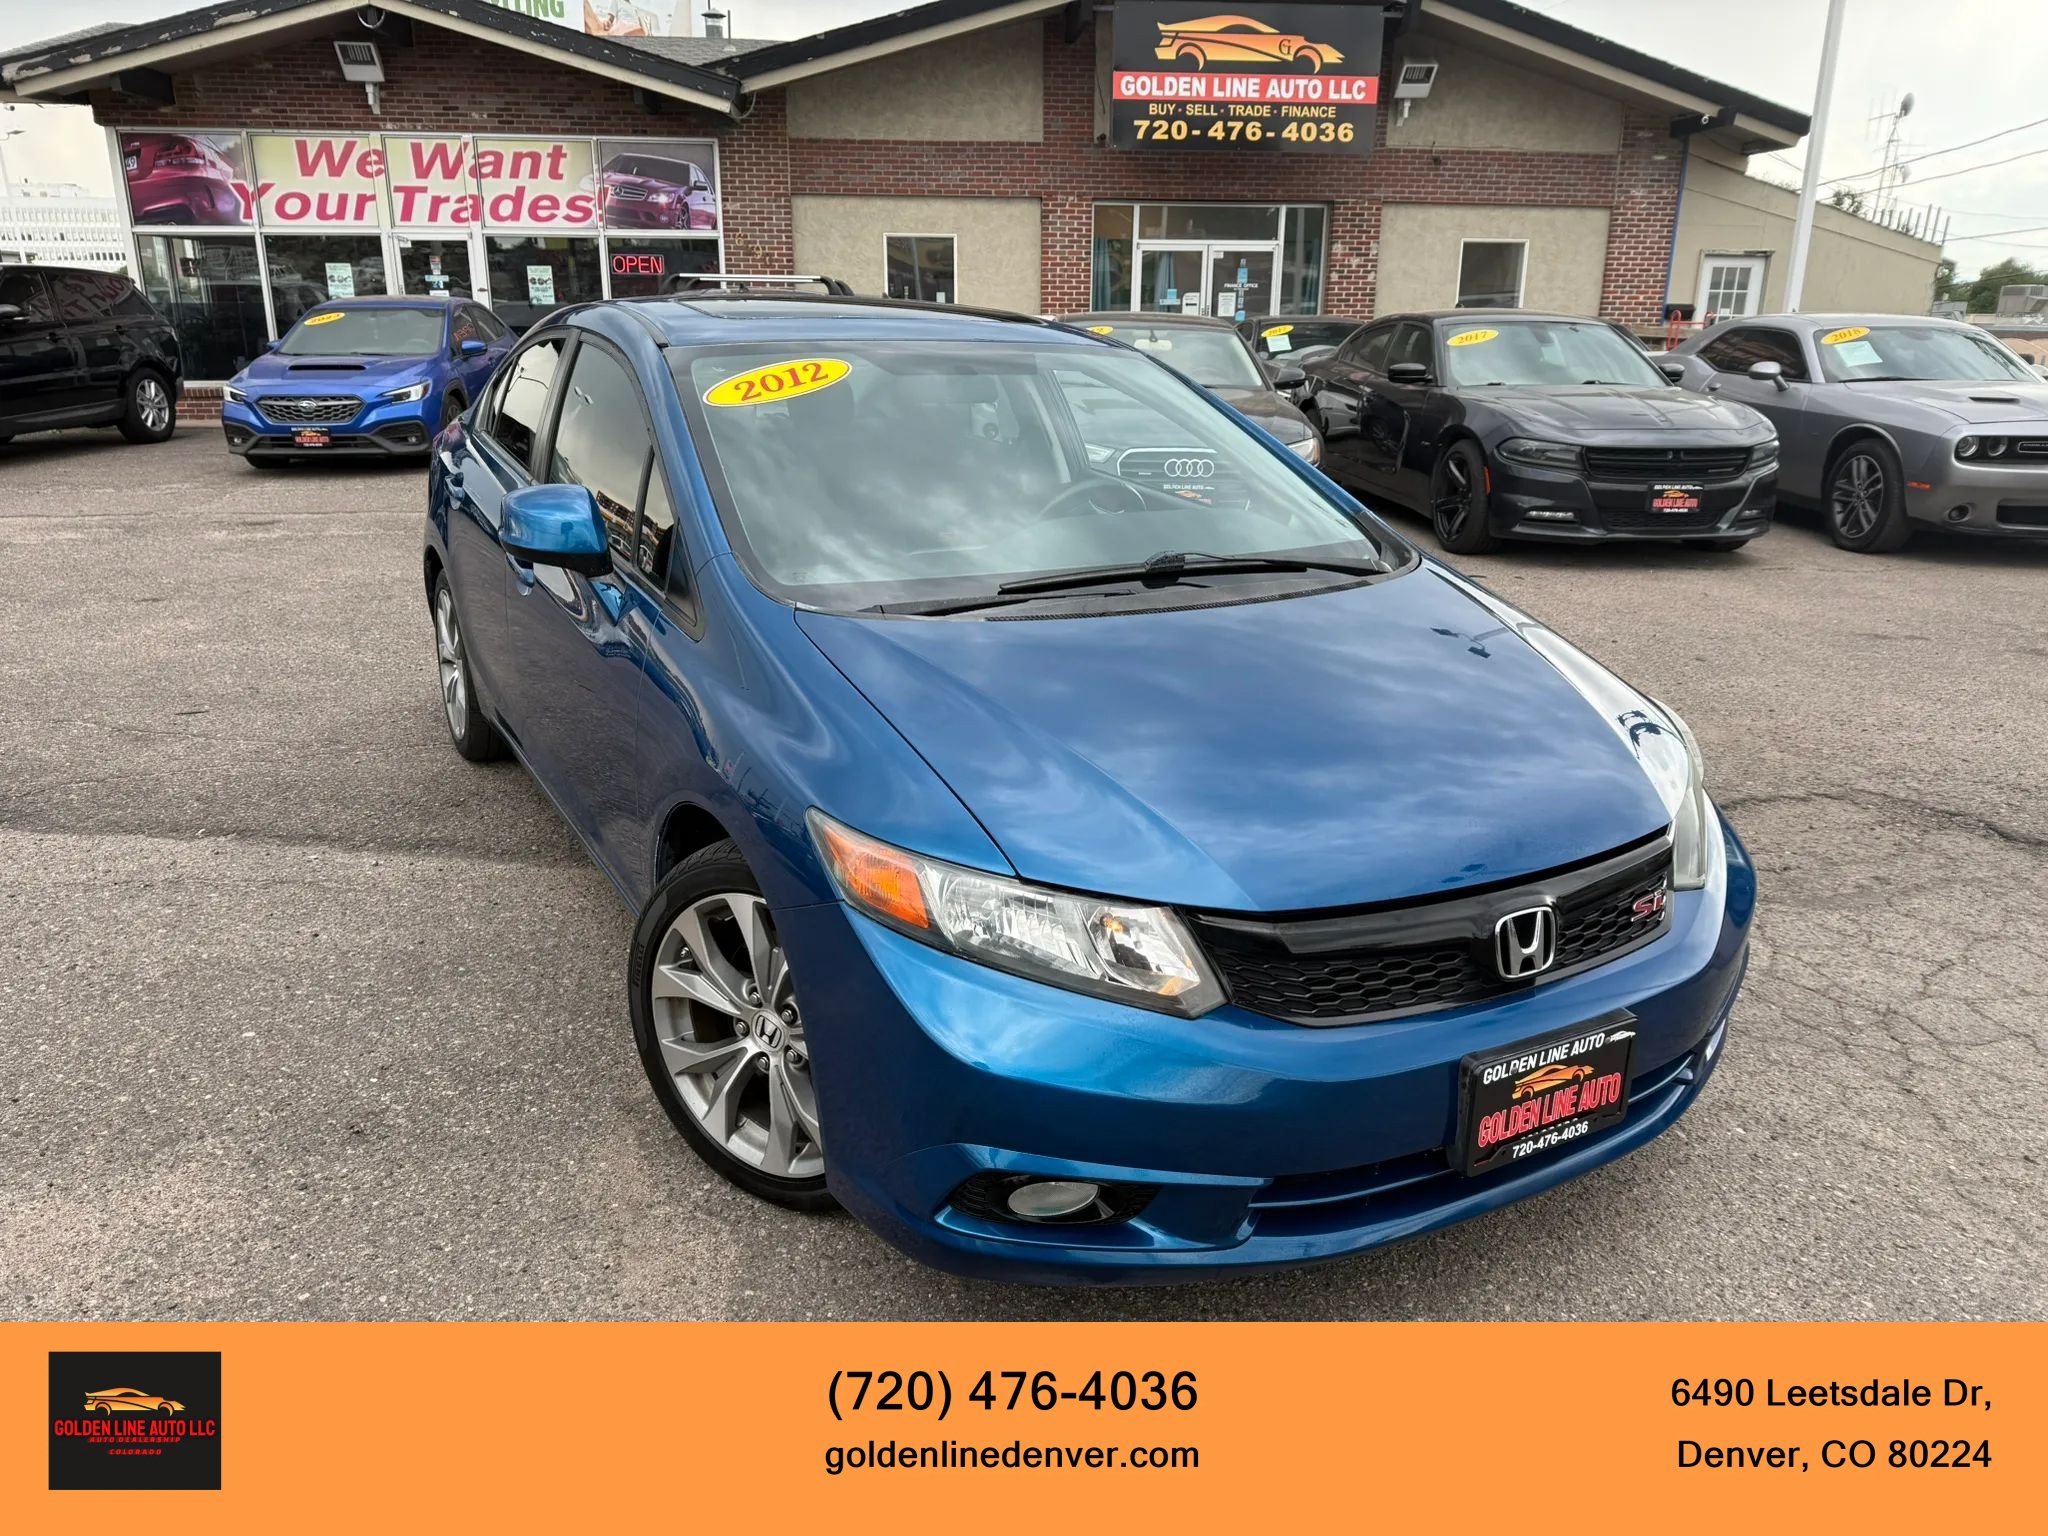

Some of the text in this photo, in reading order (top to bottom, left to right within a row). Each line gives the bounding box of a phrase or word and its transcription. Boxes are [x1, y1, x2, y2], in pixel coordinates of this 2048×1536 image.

[1120, 75, 1367, 100] GOLDEN LINE AUTO LLC
[1149, 103, 1337, 118] BUY SELL TRADE FINANCE
[295, 139, 568, 181] We Want
[231, 183, 610, 223] Your Trades!
[612, 255, 663, 274] OPEN
[1457, 330, 1488, 344] 2017
[1831, 329, 1861, 341] 2018
[734, 362, 829, 402] 2012
[1483, 1032, 1605, 1085] GOLDEN LINE AUTO
[1478, 1097, 1542, 1147] GOLDEN
[1542, 1084, 1579, 1124] LINE
[1578, 1072, 1622, 1113] AUTO
[1512, 1121, 1589, 1158] 720-476-4036
